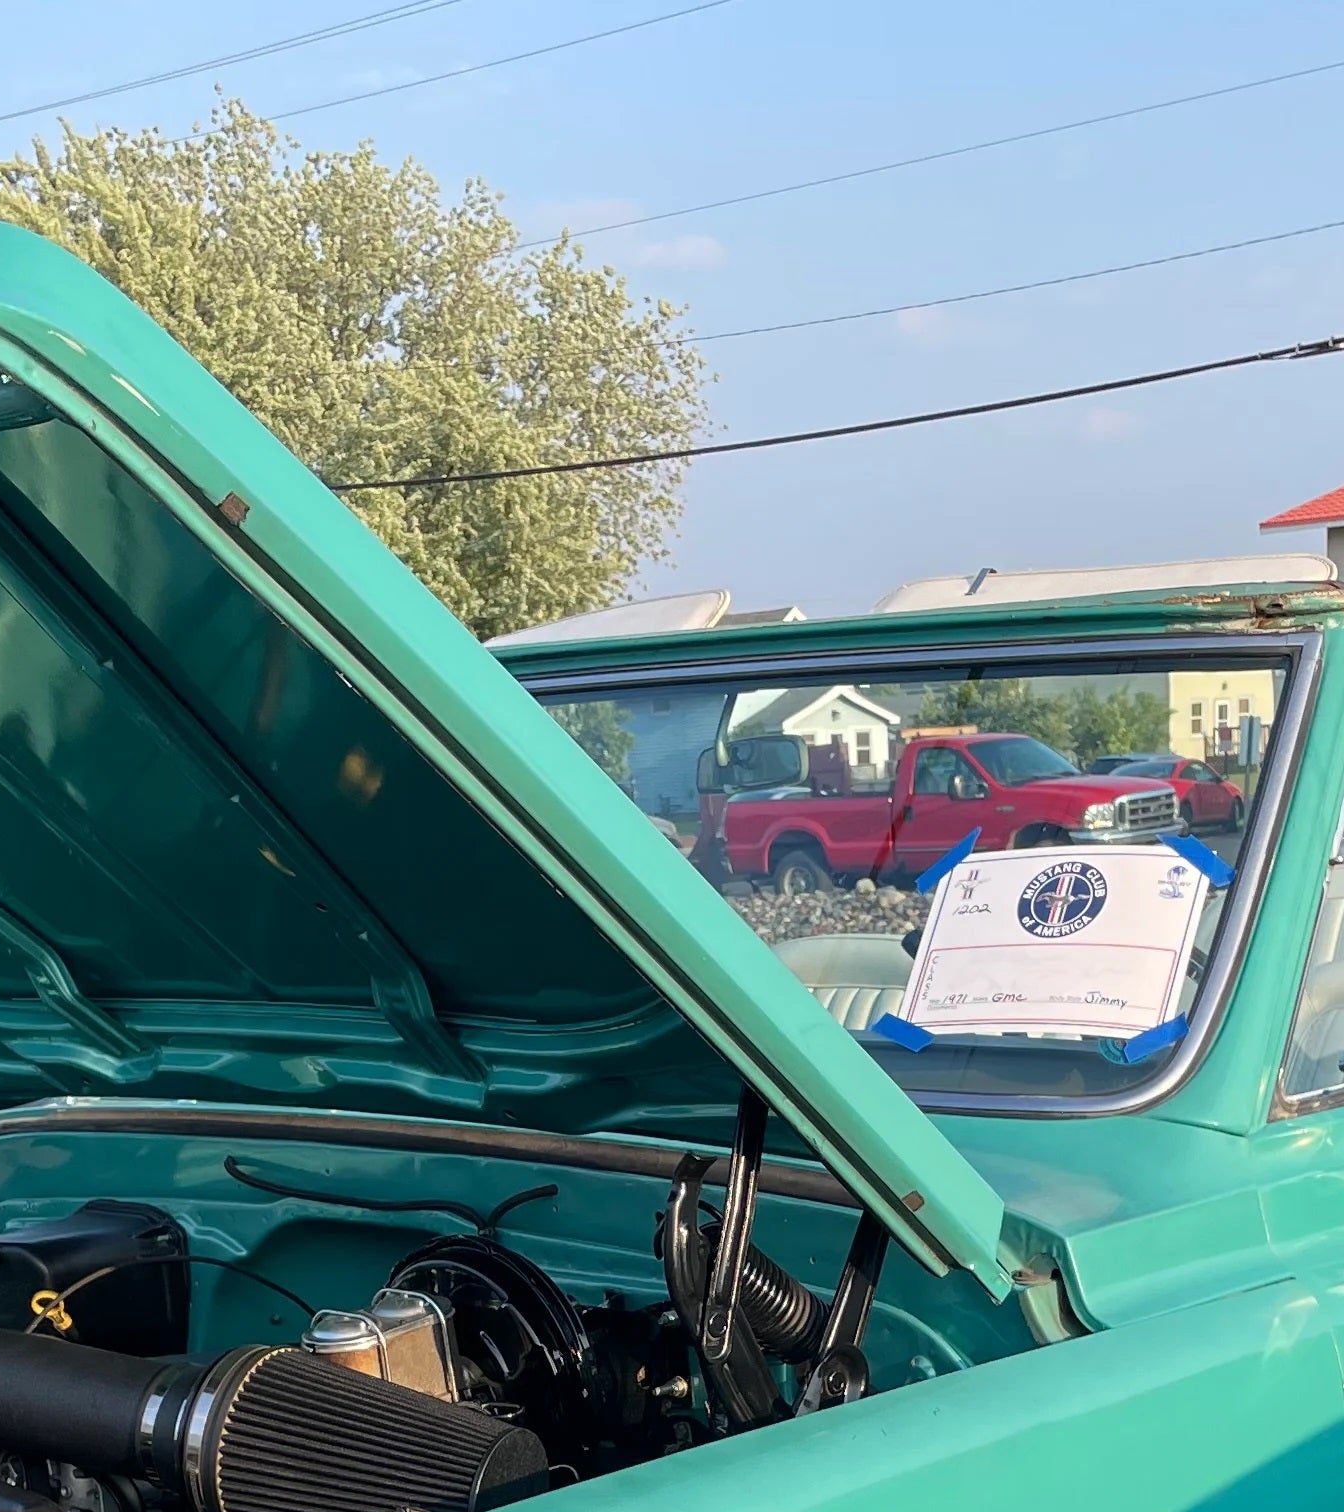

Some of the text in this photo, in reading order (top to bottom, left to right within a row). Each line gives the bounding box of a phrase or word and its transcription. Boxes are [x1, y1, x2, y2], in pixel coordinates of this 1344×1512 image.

[1022, 862, 1106, 900] MUSTANG CLUB
[952, 903, 992, 915] 1202
[1021, 915, 1093, 937] of AMERICA
[942, 993, 968, 1005] 1971
[1084, 990, 1129, 1010] Jimmy
